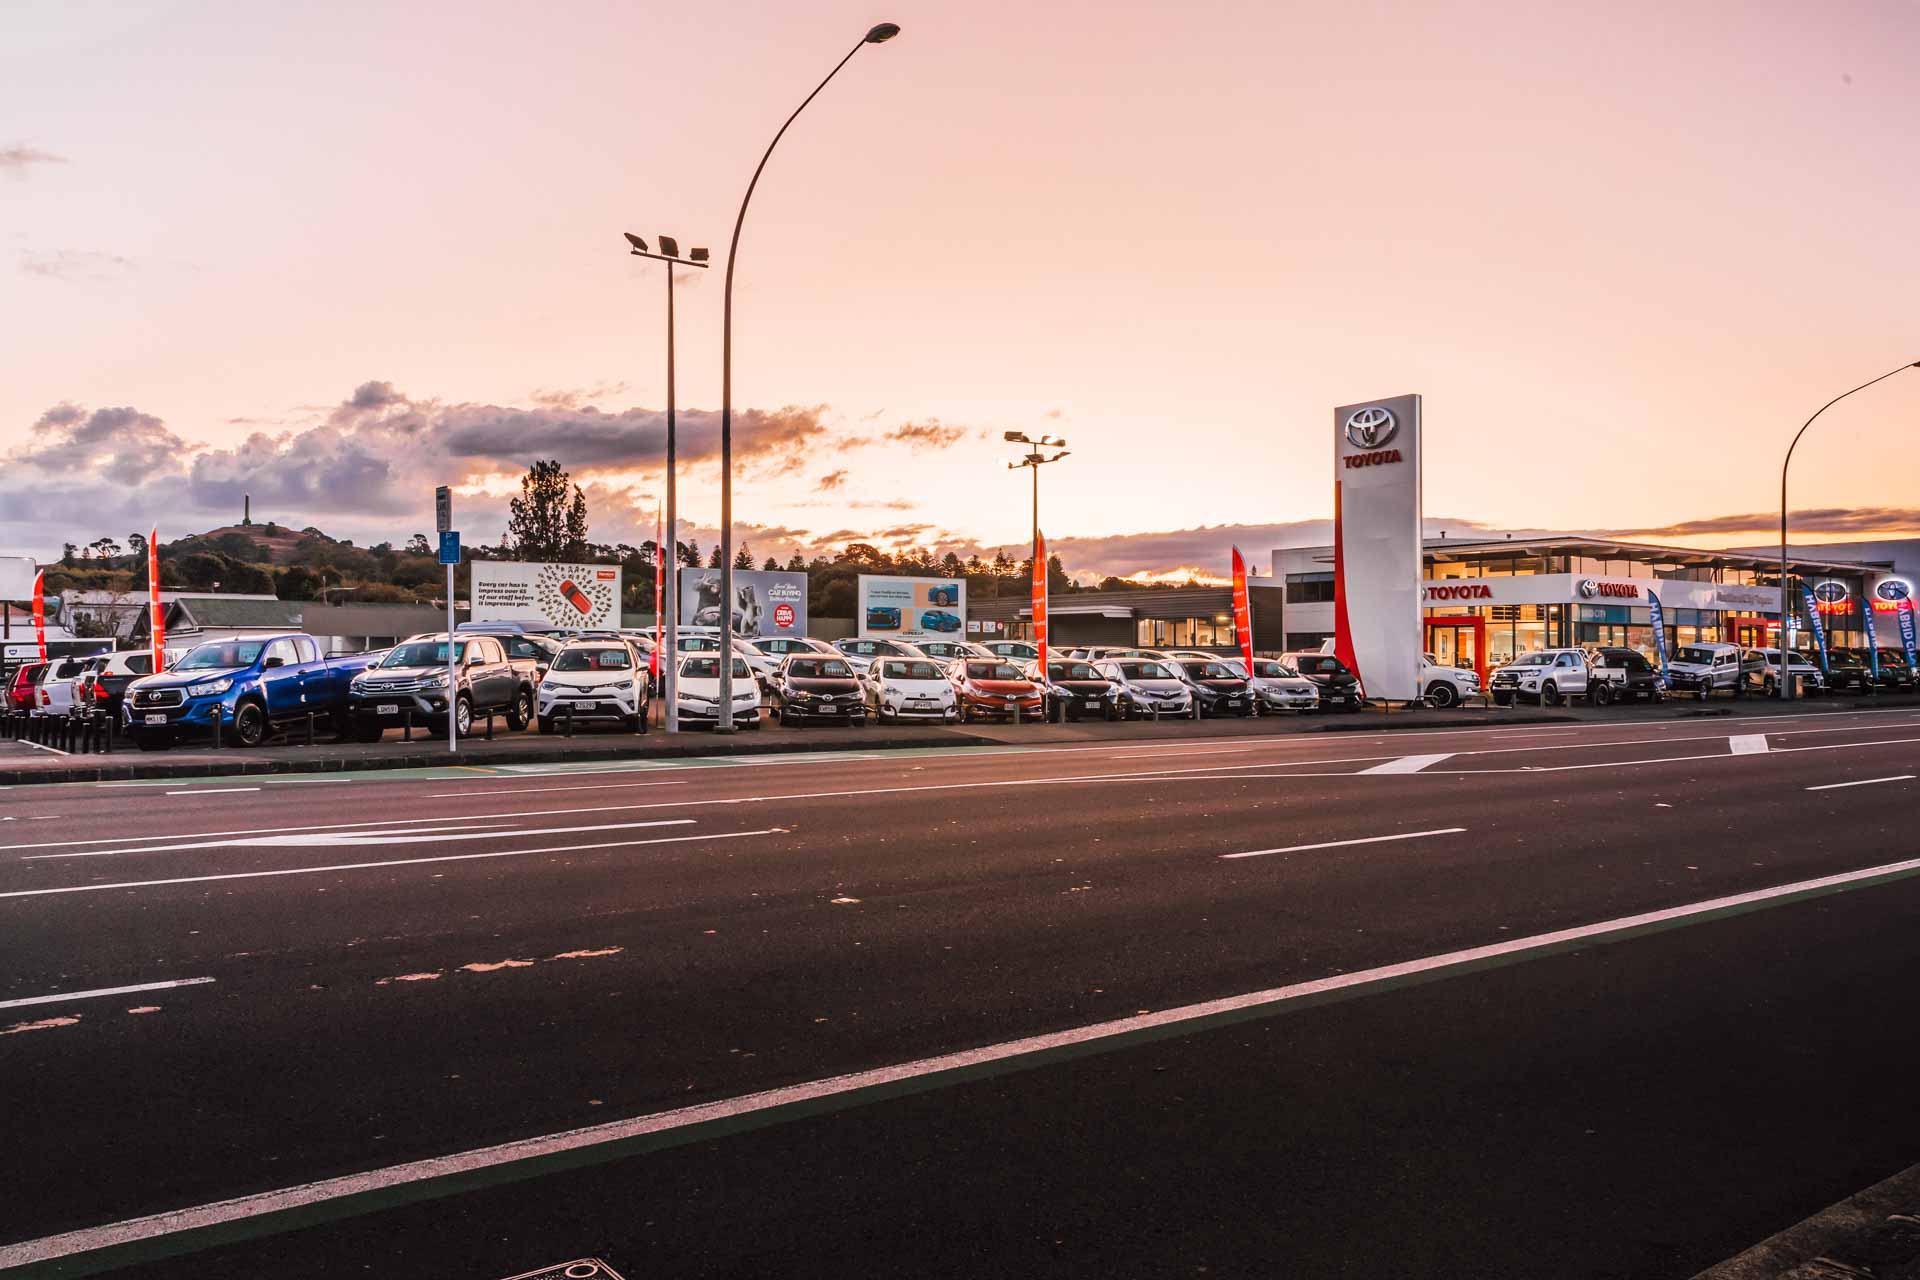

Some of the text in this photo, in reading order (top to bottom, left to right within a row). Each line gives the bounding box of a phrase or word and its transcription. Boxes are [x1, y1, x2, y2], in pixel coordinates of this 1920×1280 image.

[1343, 449, 1402, 469] TOYOTA
[1428, 585, 1492, 600] TOYOTA
[1599, 583, 1638, 598] TOYOTA
